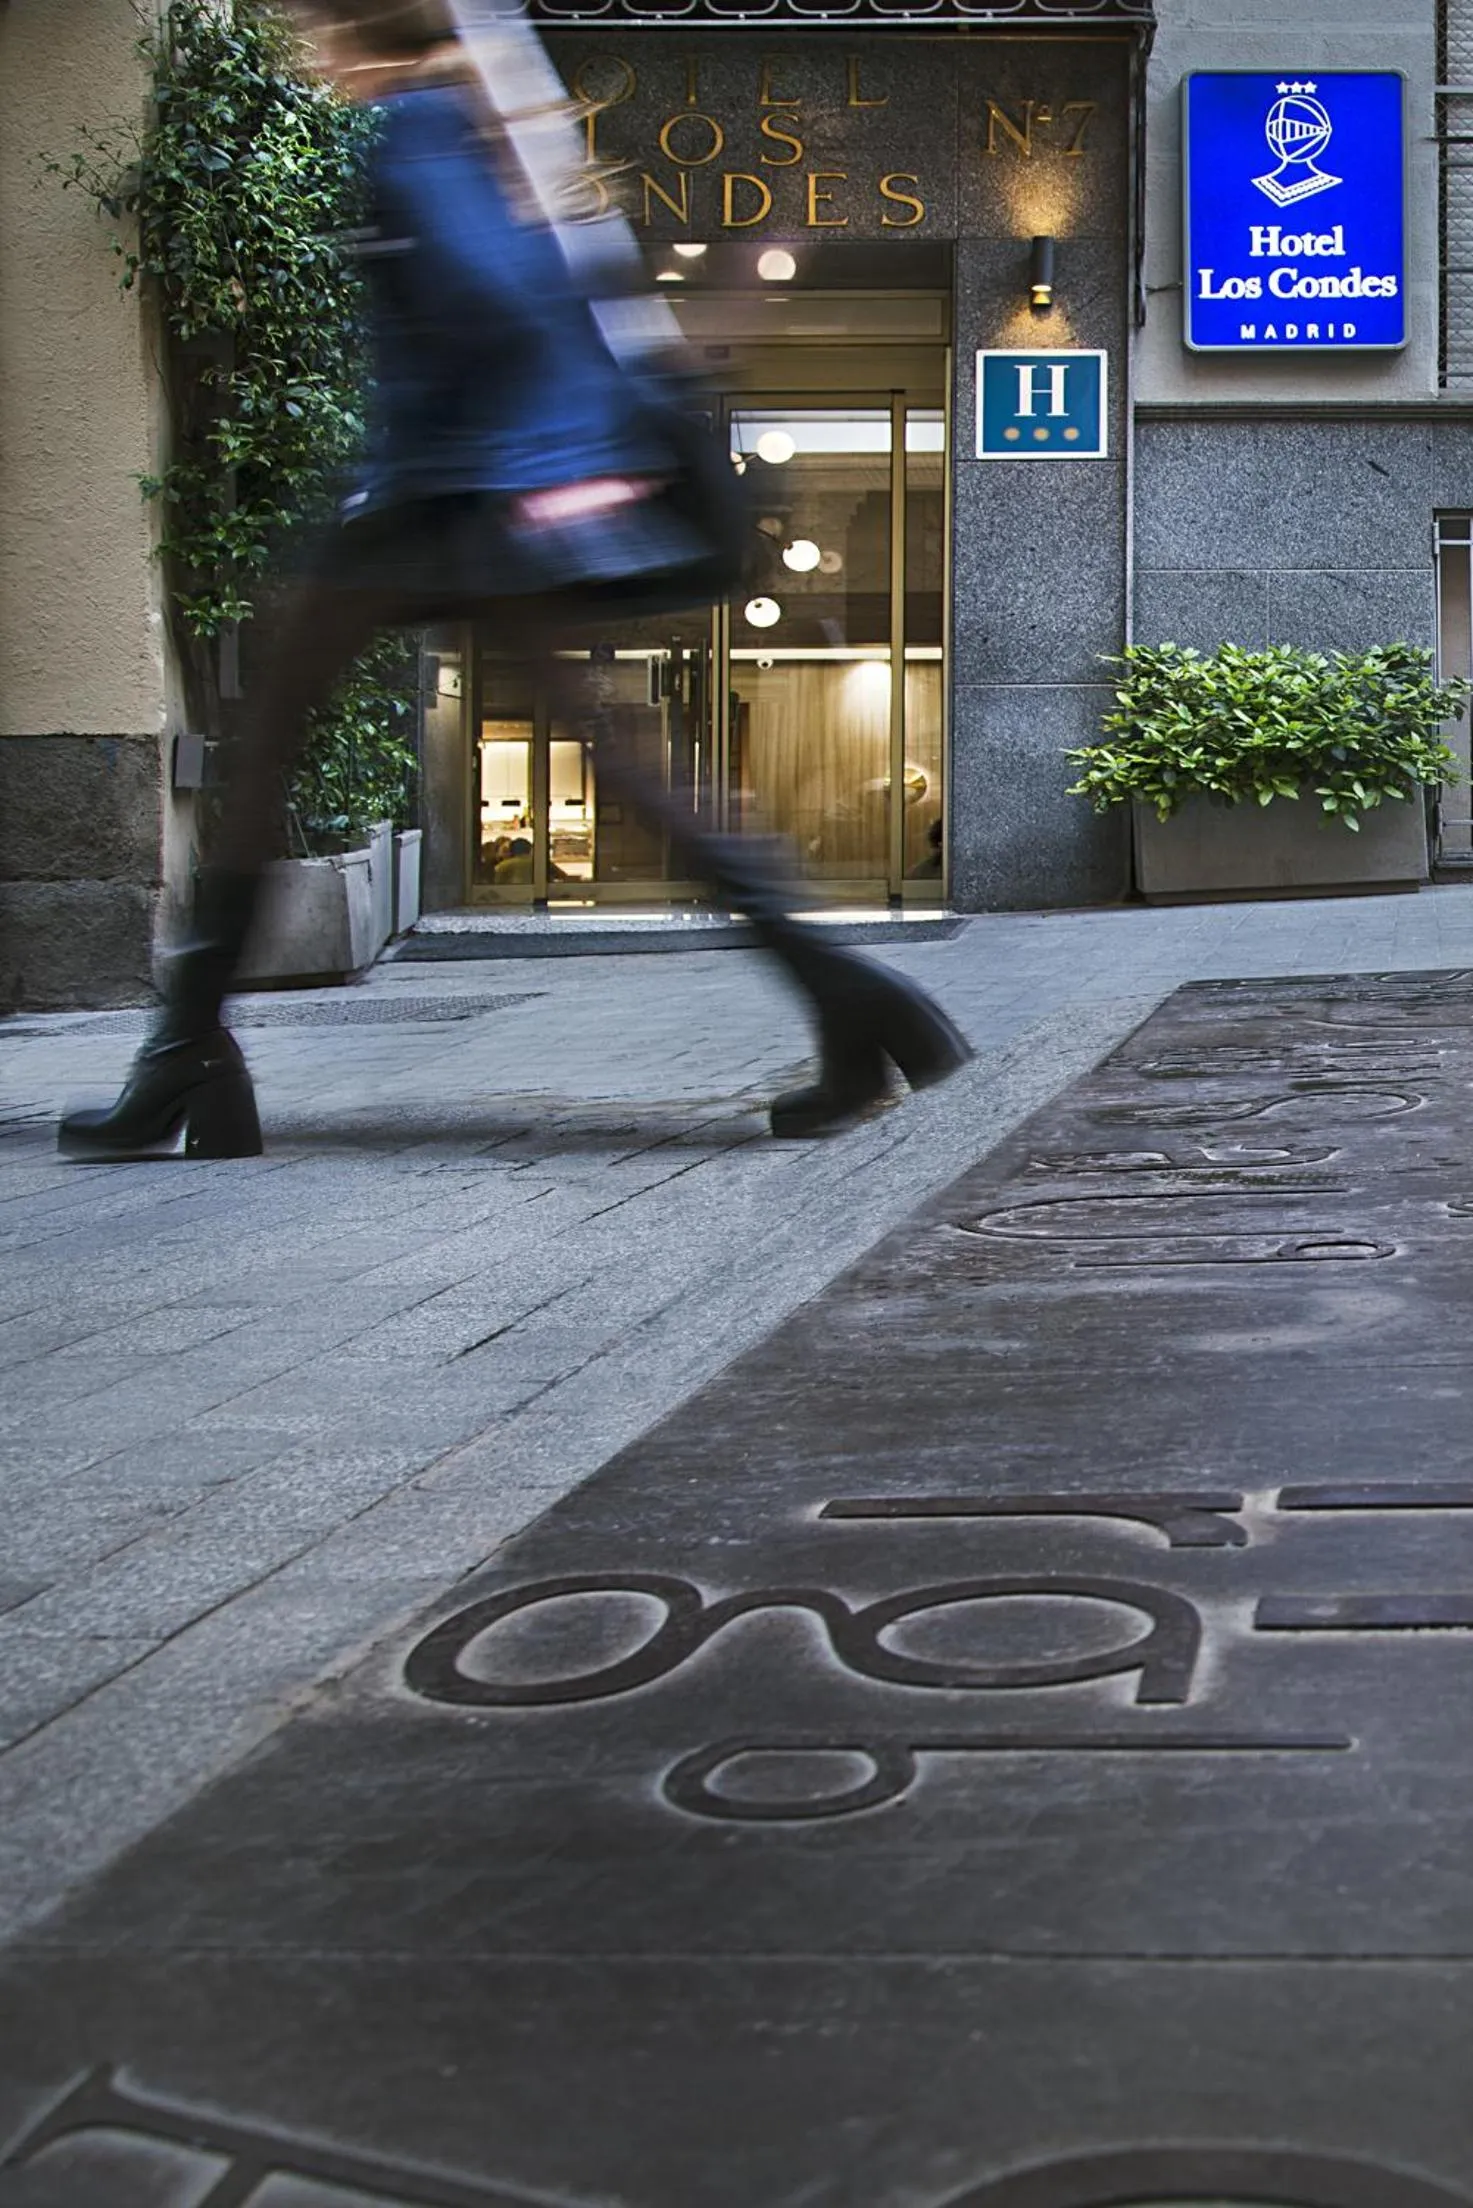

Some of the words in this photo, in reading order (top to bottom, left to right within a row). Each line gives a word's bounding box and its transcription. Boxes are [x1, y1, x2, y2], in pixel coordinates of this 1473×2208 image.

[574, 55, 889, 107] OTEL
[584, 112, 804, 167] LOS
[1249, 225, 1346, 256] Hotel
[1198, 269, 1262, 299] Los
[1268, 267, 1398, 298] Condes
[1240, 322, 1357, 339] MADRID
[1013, 364, 1070, 417] H
